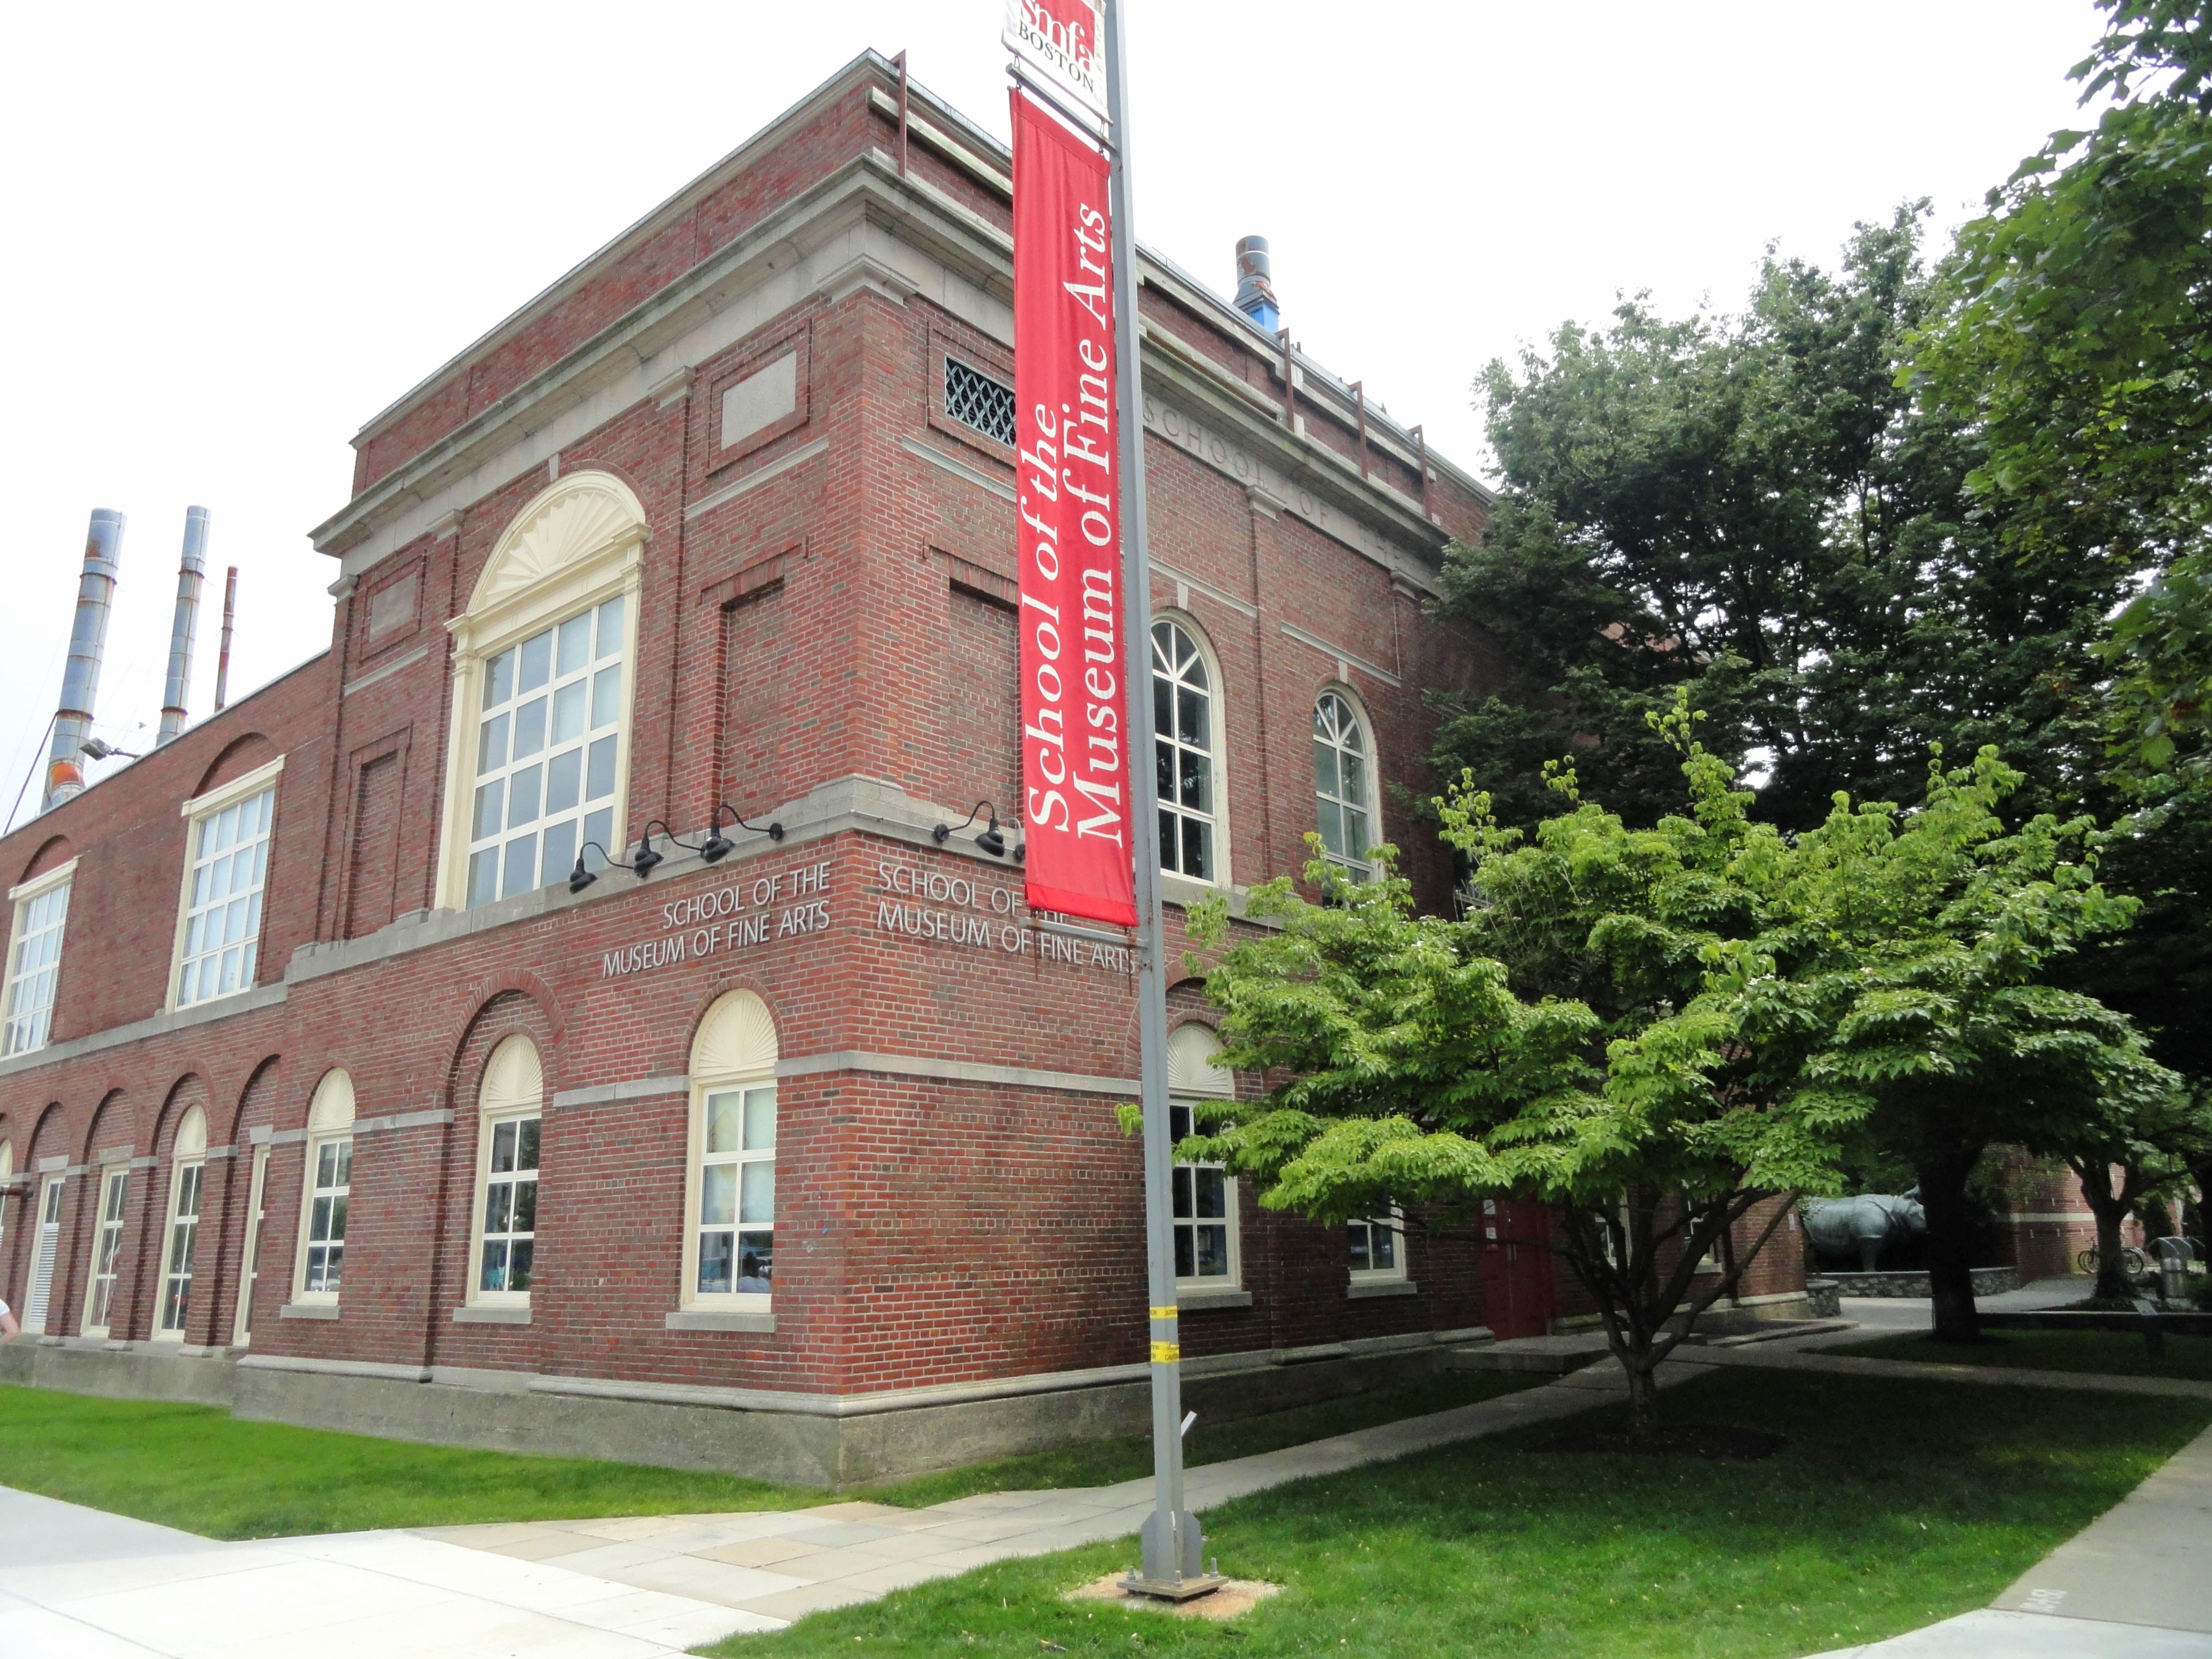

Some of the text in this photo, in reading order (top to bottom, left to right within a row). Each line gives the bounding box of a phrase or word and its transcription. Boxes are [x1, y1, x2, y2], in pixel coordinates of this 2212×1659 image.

[1018, 19, 1094, 94] BOSTON
[1142, 396, 1269, 490] SCHOOL
[1062, 203, 1122, 848] Museum of Fine Arts
[1020, 403, 1070, 832] School of the
[663, 861, 831, 929] SCHOOL OF THE
[879, 862, 1023, 916] SCHOOL OF
[602, 900, 831, 979] MUSEUM OF FINE ARTS
[877, 901, 1136, 973] MUSEUM OF FINE ARTS
